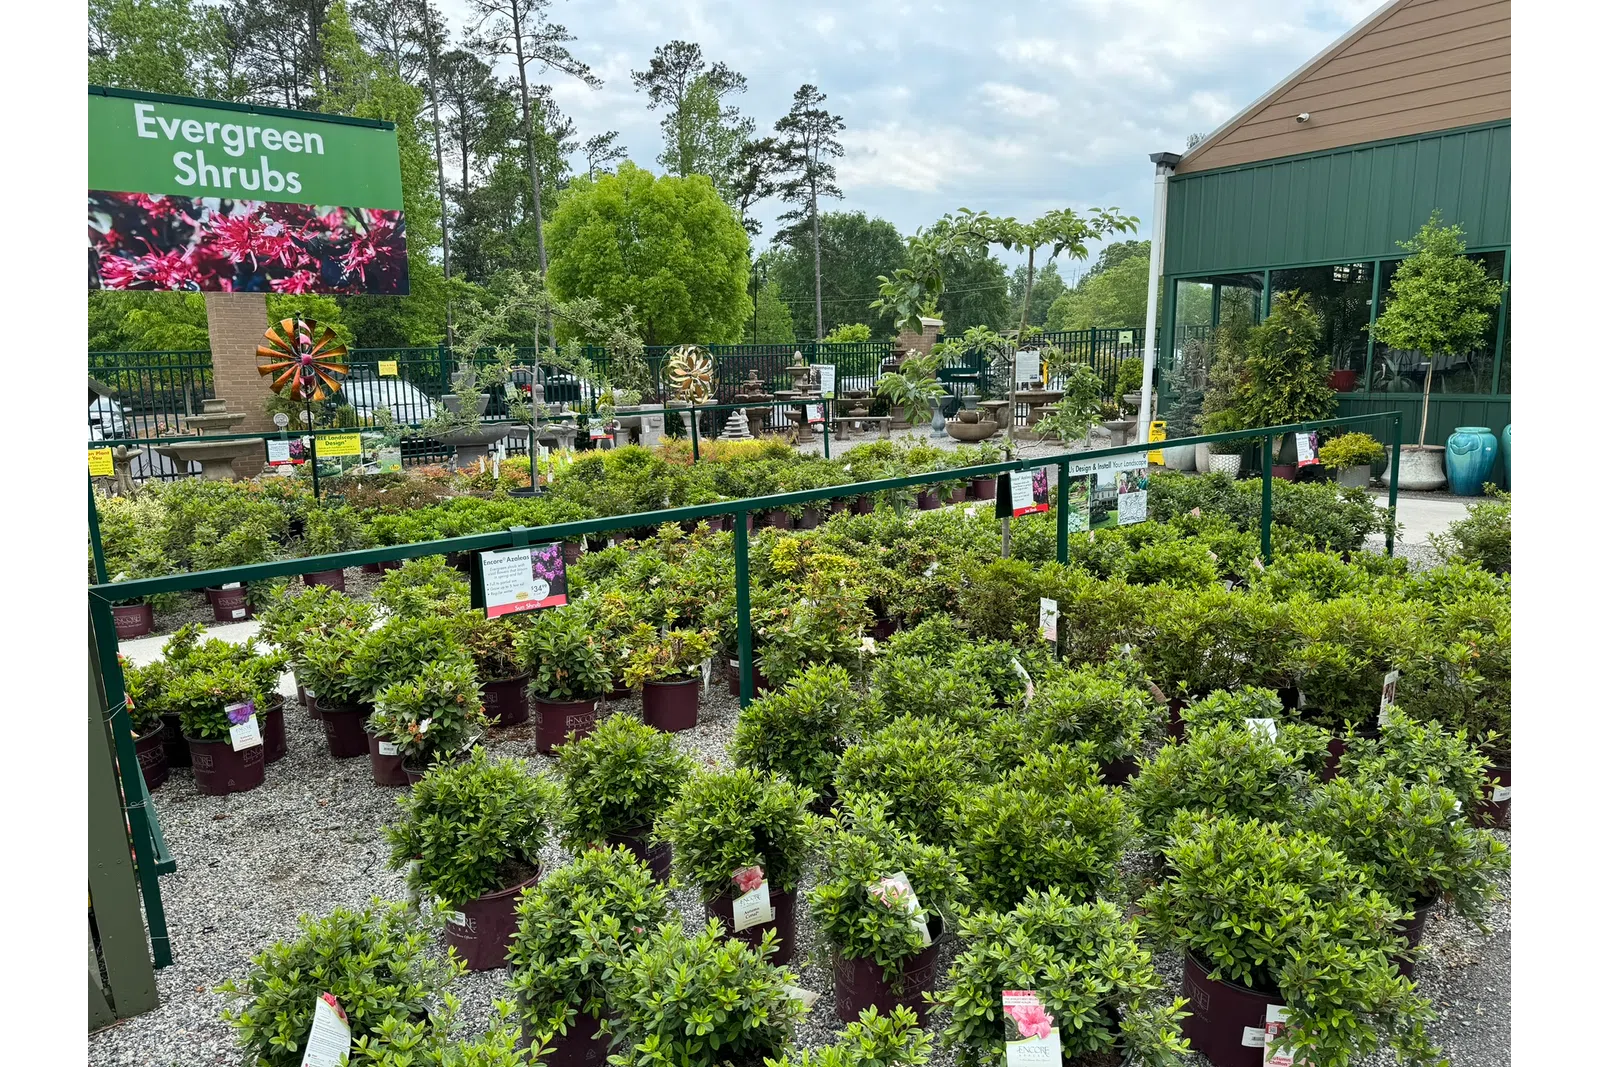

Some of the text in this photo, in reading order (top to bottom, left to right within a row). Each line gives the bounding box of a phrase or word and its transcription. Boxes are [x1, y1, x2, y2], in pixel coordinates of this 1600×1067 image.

[134, 102, 325, 157] Evergreen
[173, 149, 302, 194] Shrubs
[1076, 465, 1091, 473] Design
[1098, 461, 1111, 469] Install
[1124, 459, 1146, 467] Landscape
[1018, 1046, 1050, 1057] ENCORE
